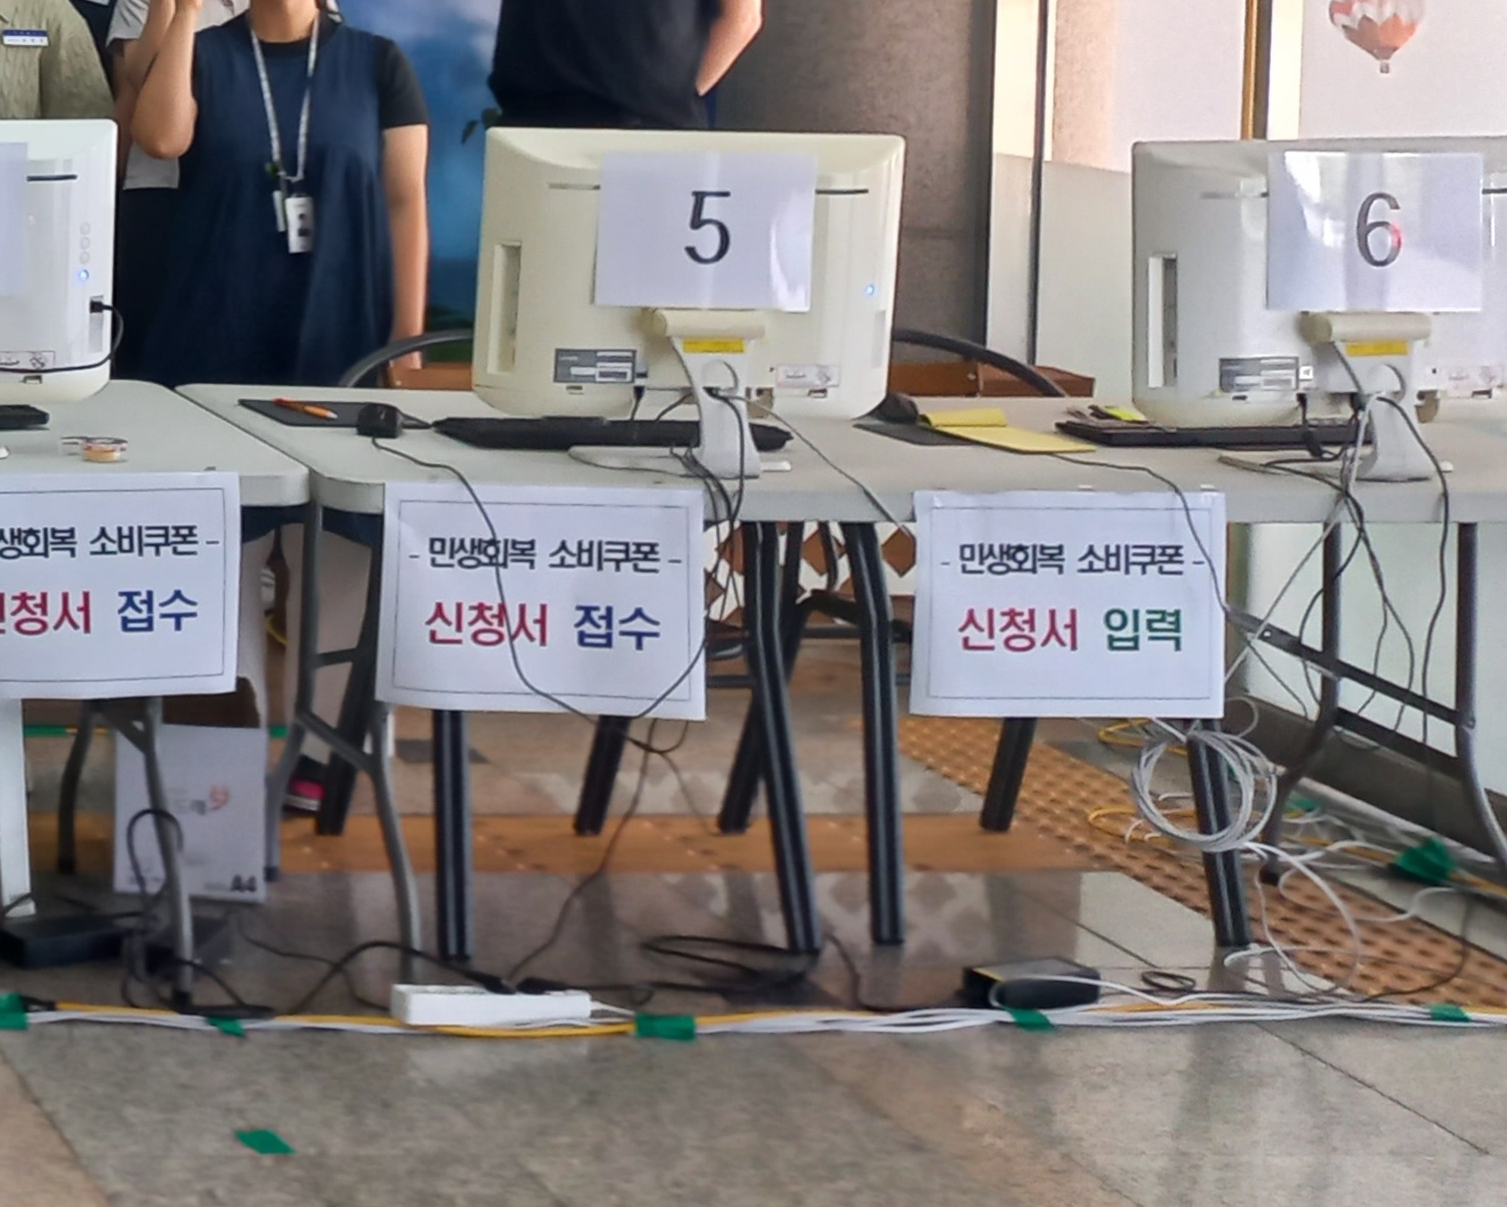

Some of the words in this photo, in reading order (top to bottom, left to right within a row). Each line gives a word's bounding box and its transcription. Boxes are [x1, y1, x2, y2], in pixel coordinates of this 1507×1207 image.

[684, 190, 731, 264] 5
[1356, 192, 1402, 268] 6
[89, 524, 199, 557] 소비쿠폰
[429, 536, 536, 570] 민생회복
[548, 539, 660, 573] 소비쿠폰
[959, 543, 1065, 575] 민생회복
[1077, 543, 1184, 576] 소비쿠폰
[117, 589, 198, 633] 접수
[425, 601, 548, 647] 신청서
[574, 604, 660, 651] 접수
[958, 607, 1079, 652] 신청서
[1103, 607, 1182, 653] 입력
